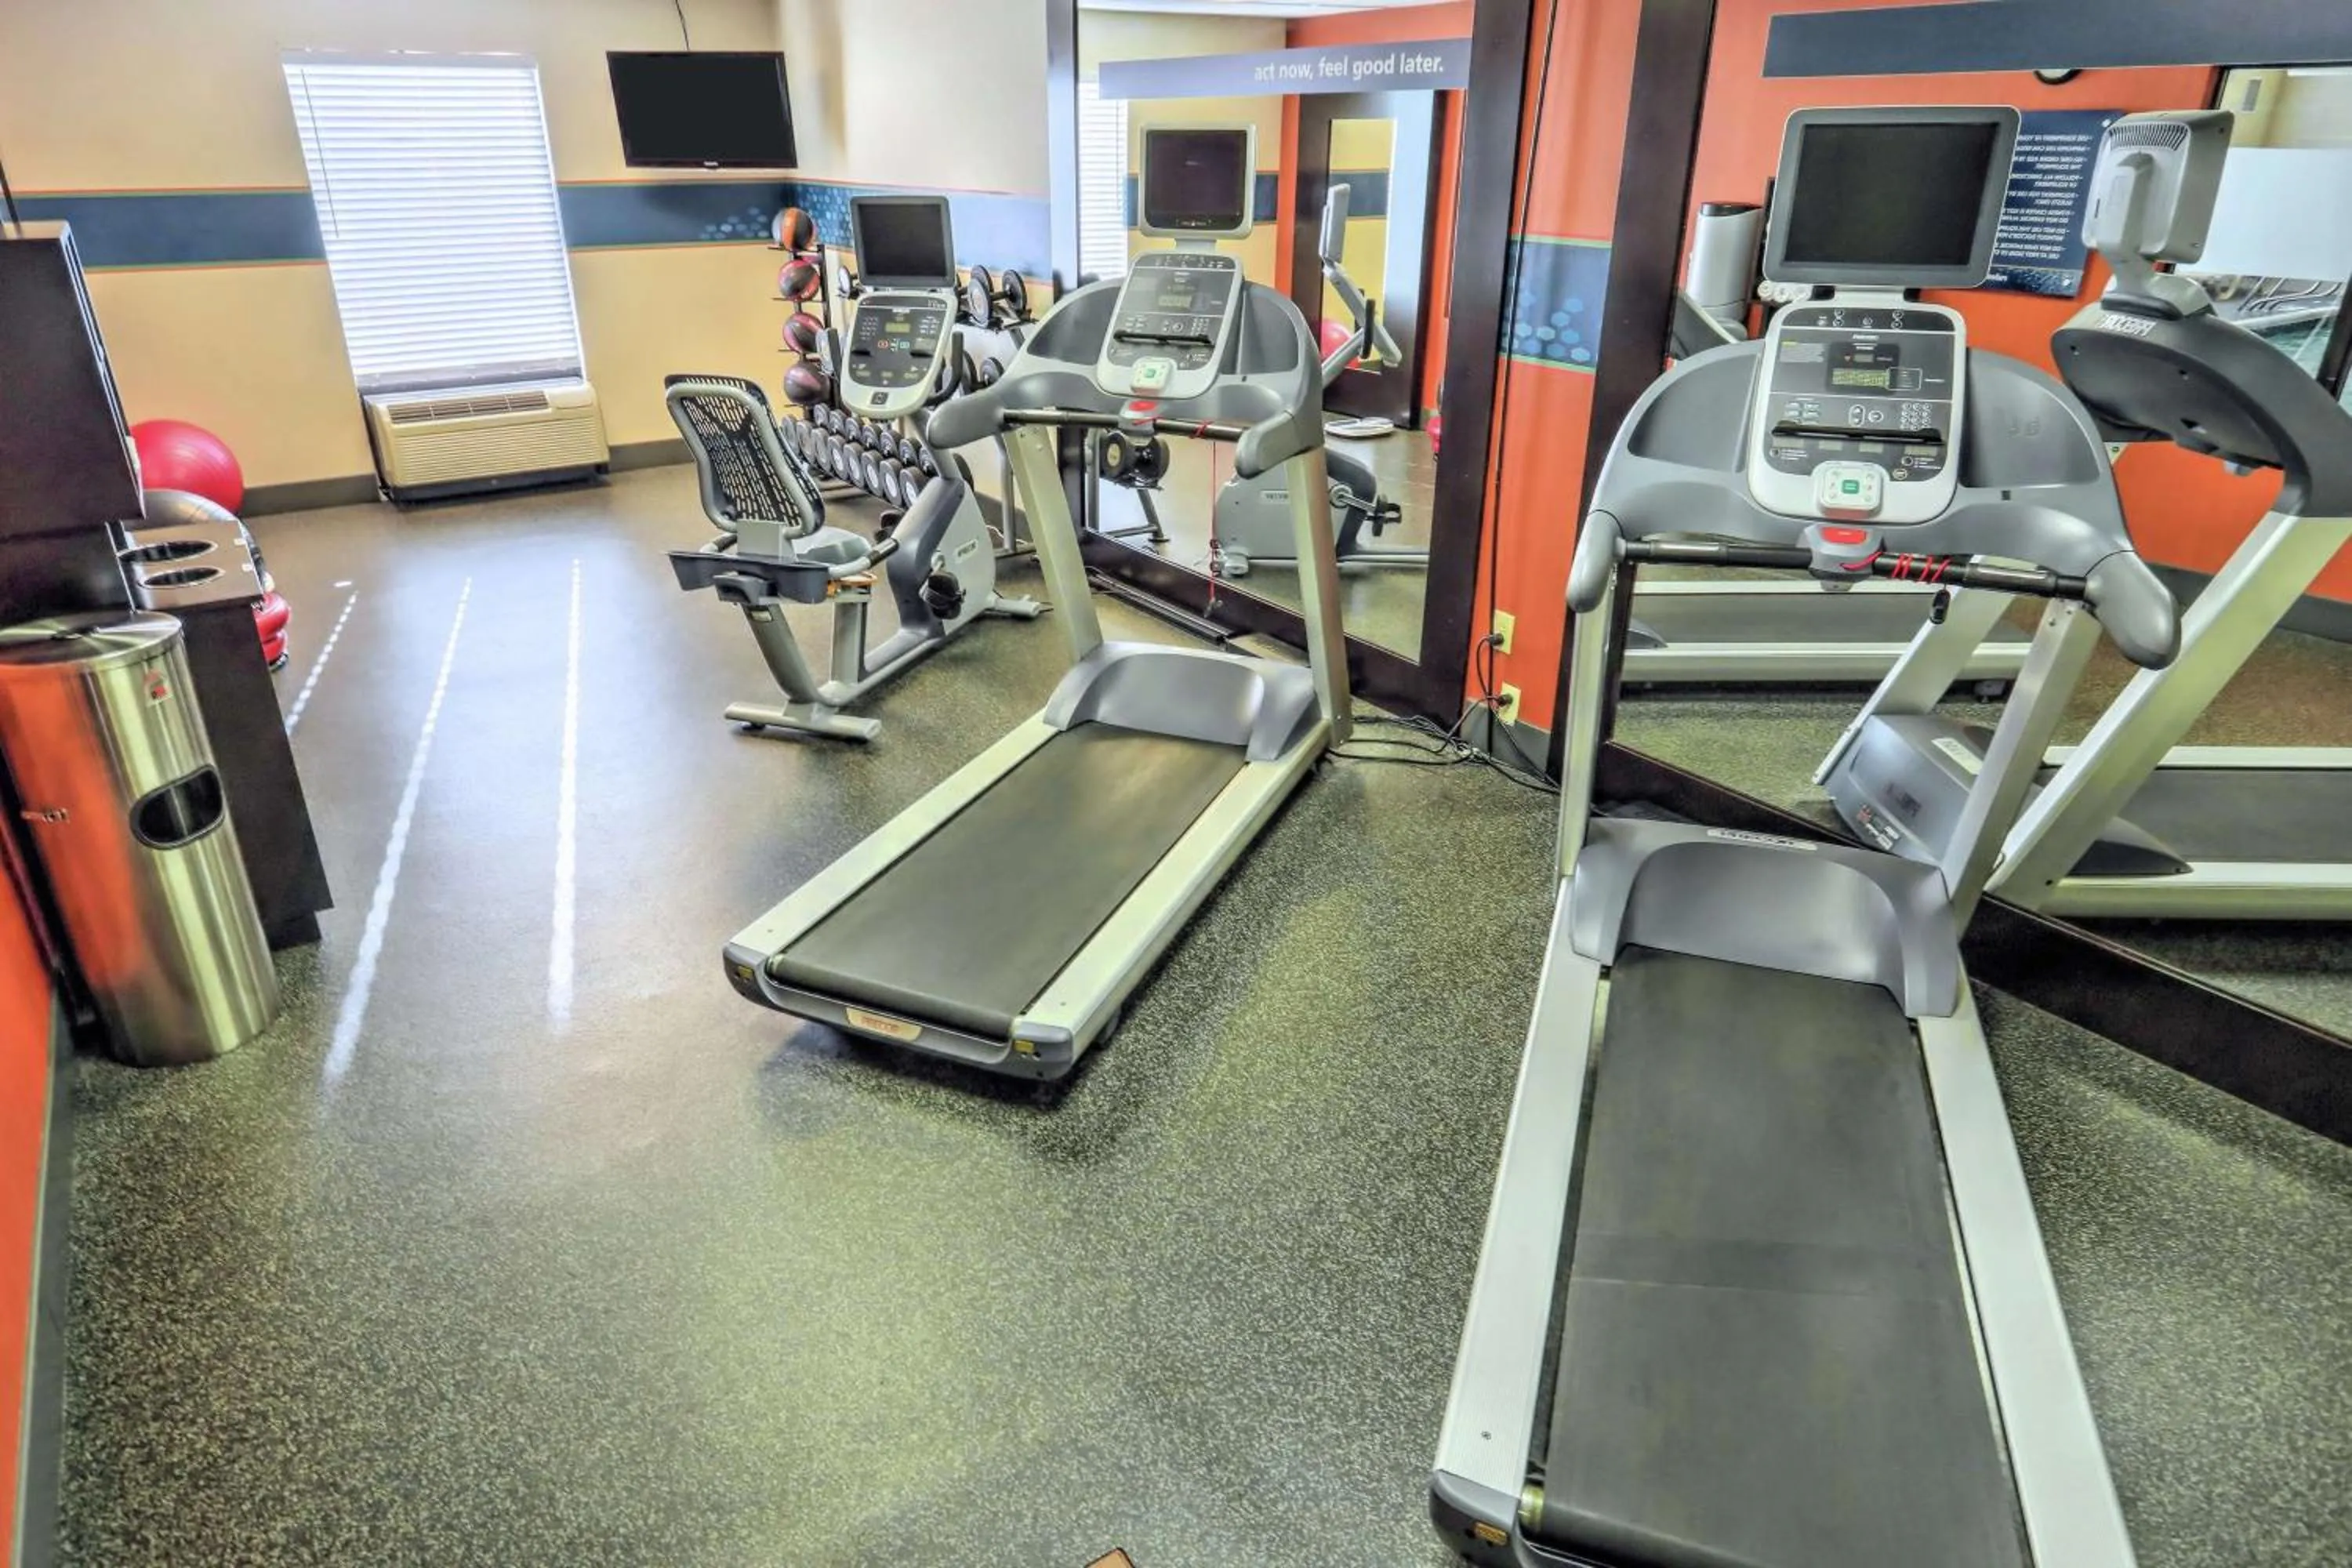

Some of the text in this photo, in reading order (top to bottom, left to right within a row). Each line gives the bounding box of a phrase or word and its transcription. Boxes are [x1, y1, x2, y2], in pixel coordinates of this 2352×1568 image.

[1254, 53, 1444, 81] act now, feel good later.
